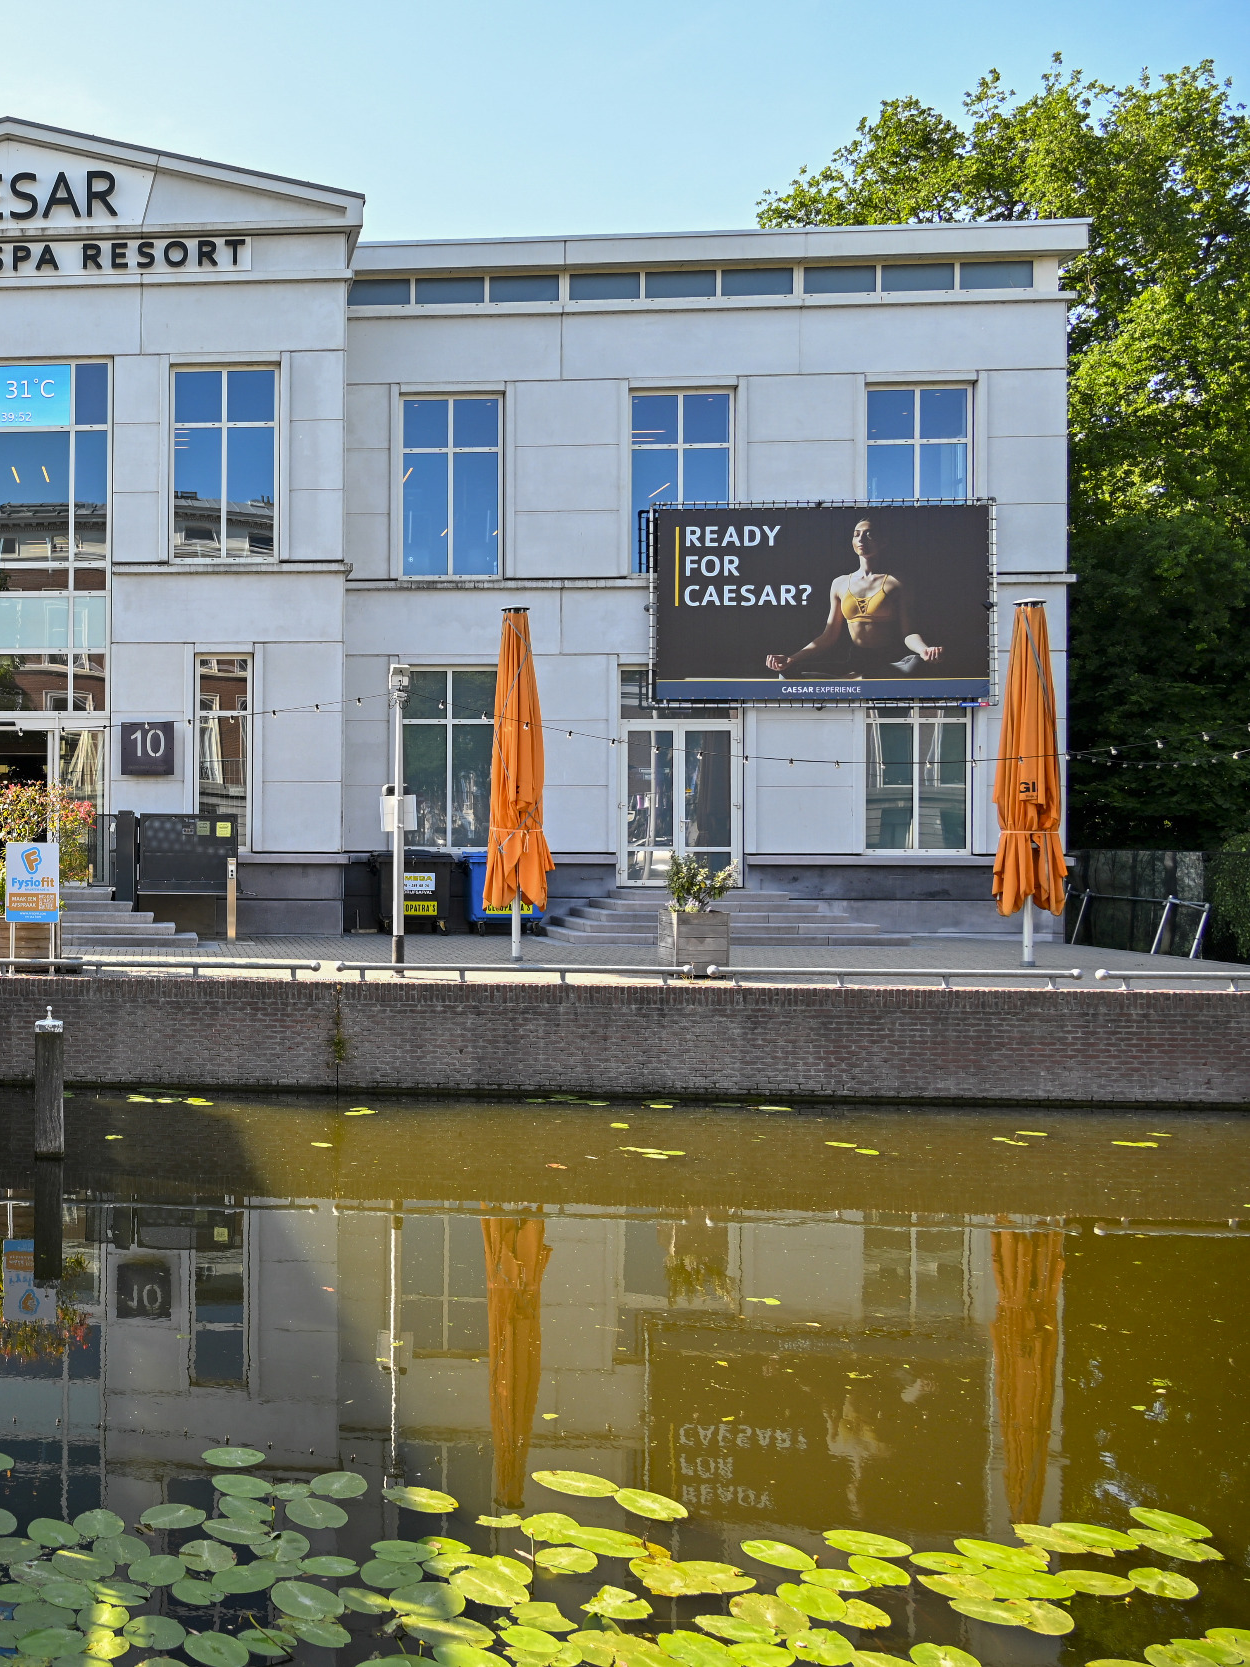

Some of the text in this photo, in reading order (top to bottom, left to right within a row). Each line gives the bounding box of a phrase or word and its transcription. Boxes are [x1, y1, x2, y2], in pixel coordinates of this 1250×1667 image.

[82, 238, 246, 270] RESORT
[5, 378, 55, 400] 31°C
[685, 525, 781, 547] READY
[685, 555, 740, 577] FOR
[684, 584, 812, 607] CAESAR?
[781, 686, 862, 694] CAESAR EXPERIENCE
[130, 729, 165, 757] 10
[11, 877, 55, 890] Fysiofit
[404, 904, 436, 913] OPATRA'S
